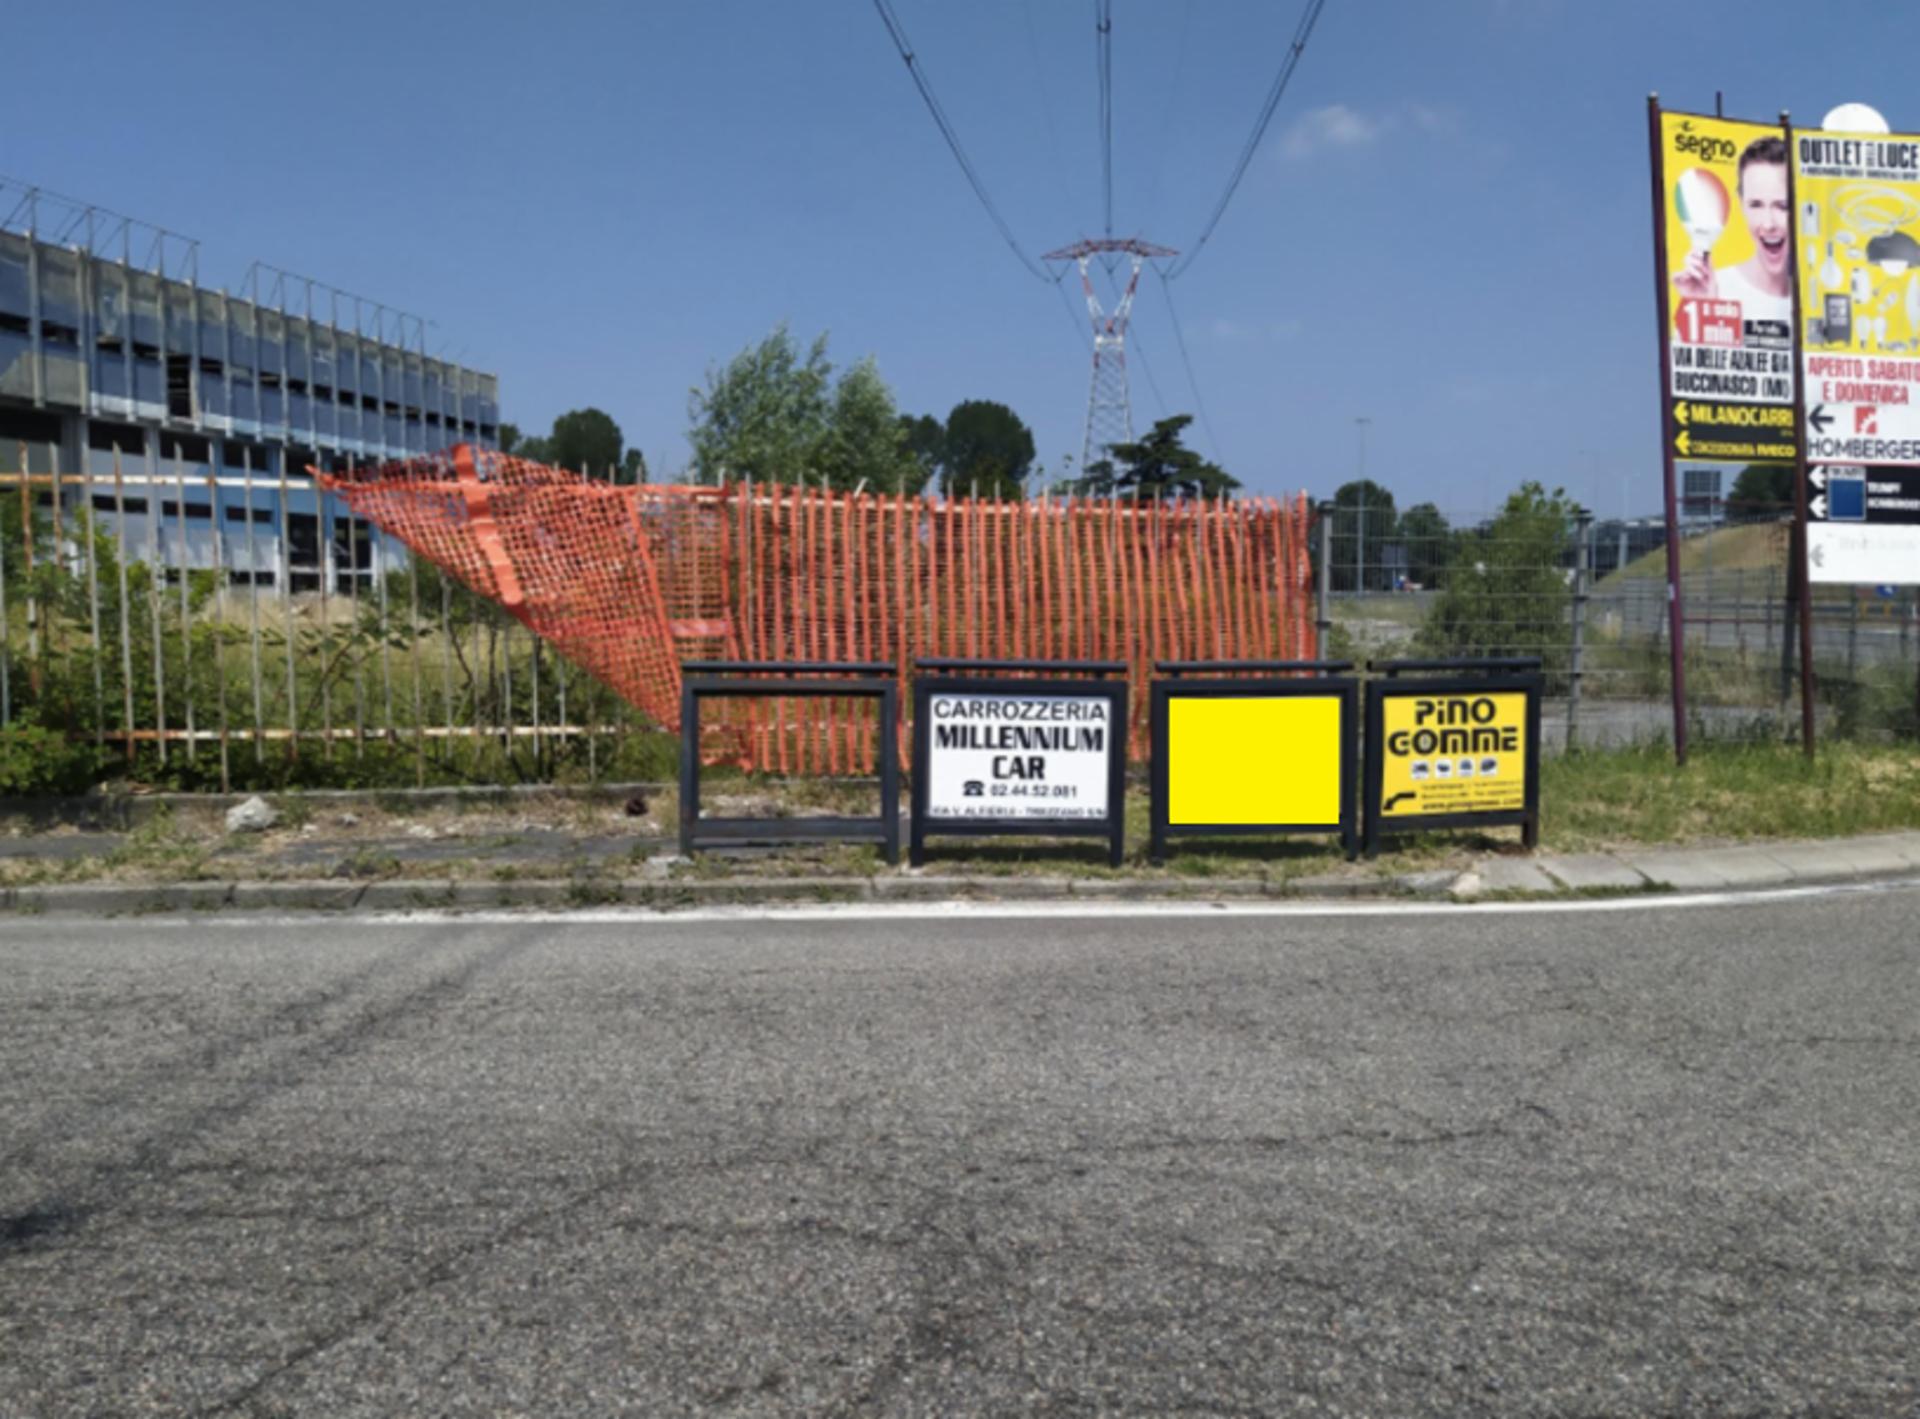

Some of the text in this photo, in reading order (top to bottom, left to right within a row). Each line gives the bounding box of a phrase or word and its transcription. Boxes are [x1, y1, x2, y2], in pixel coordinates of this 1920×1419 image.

[1675, 132, 1737, 162] segno
[1800, 137, 1861, 166] OUTLET
[1877, 142, 1918, 170] LUCE
[1674, 347, 1692, 367] VIA
[1696, 348, 1727, 370] DELLE
[1808, 357, 1864, 379] APERTO
[1675, 371, 1758, 397] BUCCINASCO
[1822, 381, 1909, 405] E DOMENICA
[1691, 403, 1794, 428] MILANOCARRI
[1757, 443, 1797, 458] IVECO
[1808, 437, 1920, 460] HOMBERGER
[933, 698, 1106, 721] CARROZZERIA
[935, 723, 1104, 752] MILLENNIUM
[1388, 726, 1518, 757] GOMME
[992, 755, 1046, 780] CAR
